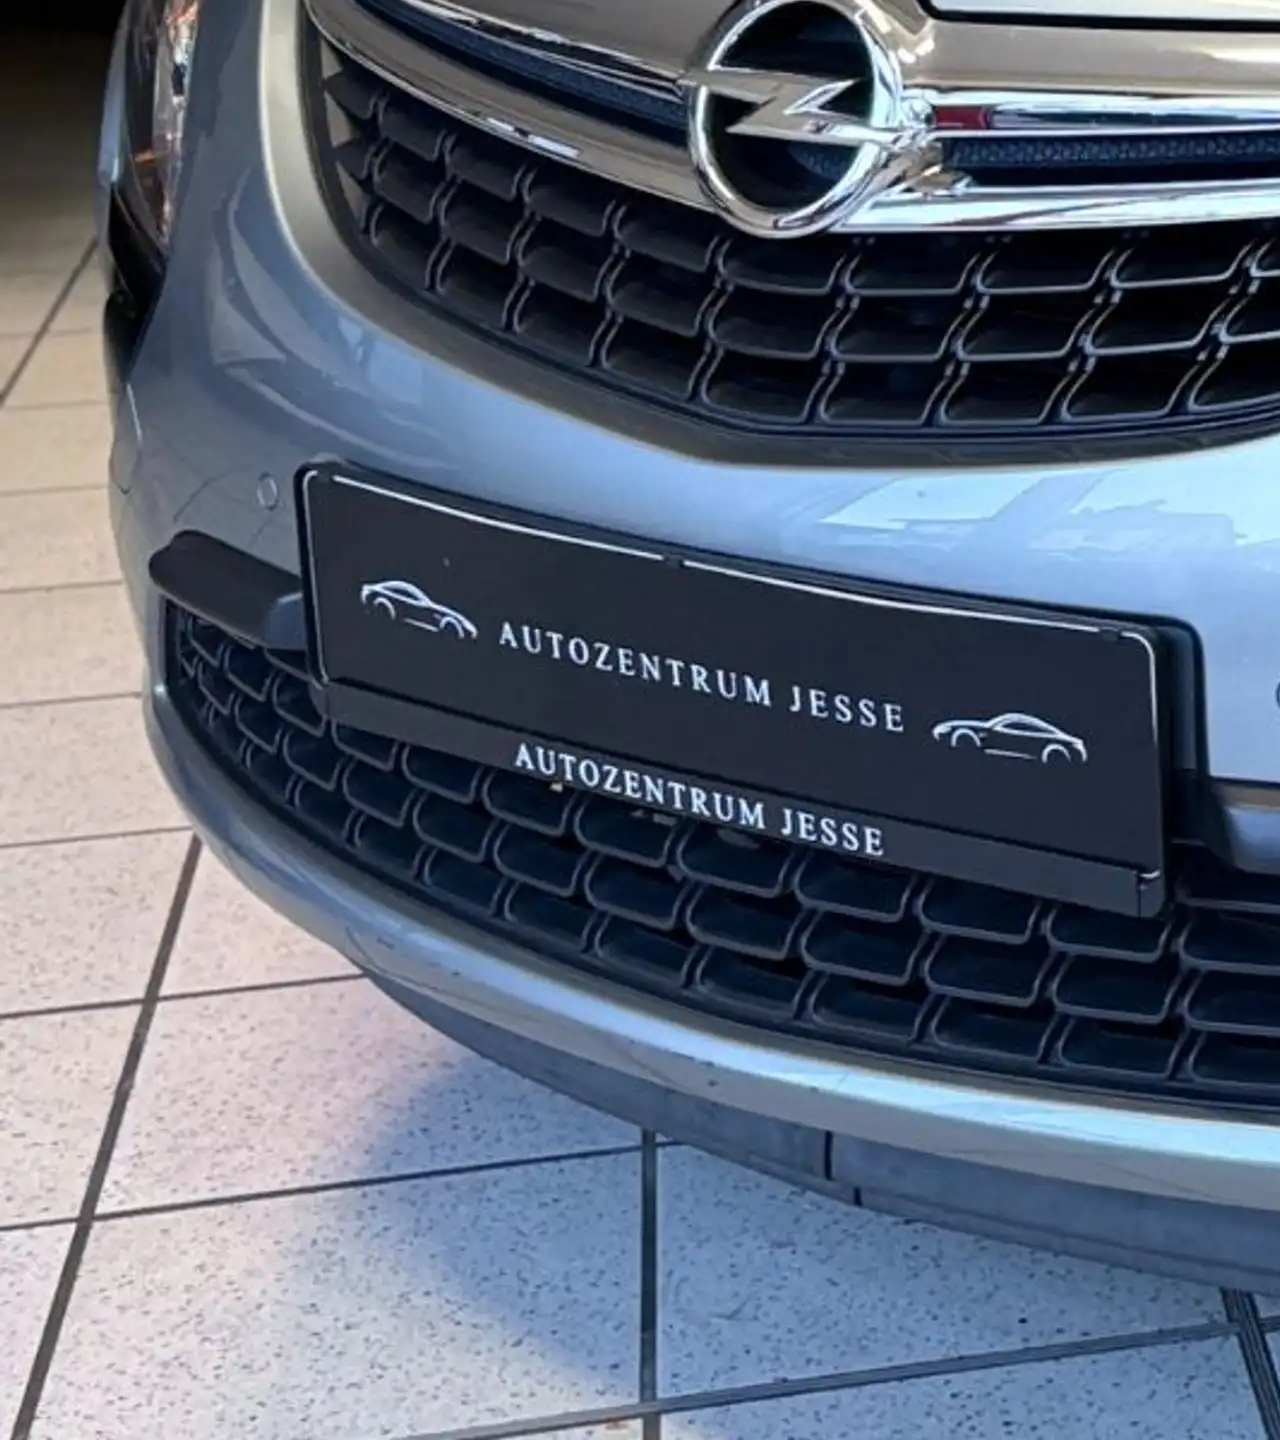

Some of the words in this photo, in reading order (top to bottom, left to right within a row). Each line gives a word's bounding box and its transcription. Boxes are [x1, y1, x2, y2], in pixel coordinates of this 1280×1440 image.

[498, 620, 772, 708] AUTOZENTRUM
[788, 684, 905, 733] JESSE
[514, 742, 767, 831] AUTOZENTRUM
[780, 807, 885, 858] JESSE
